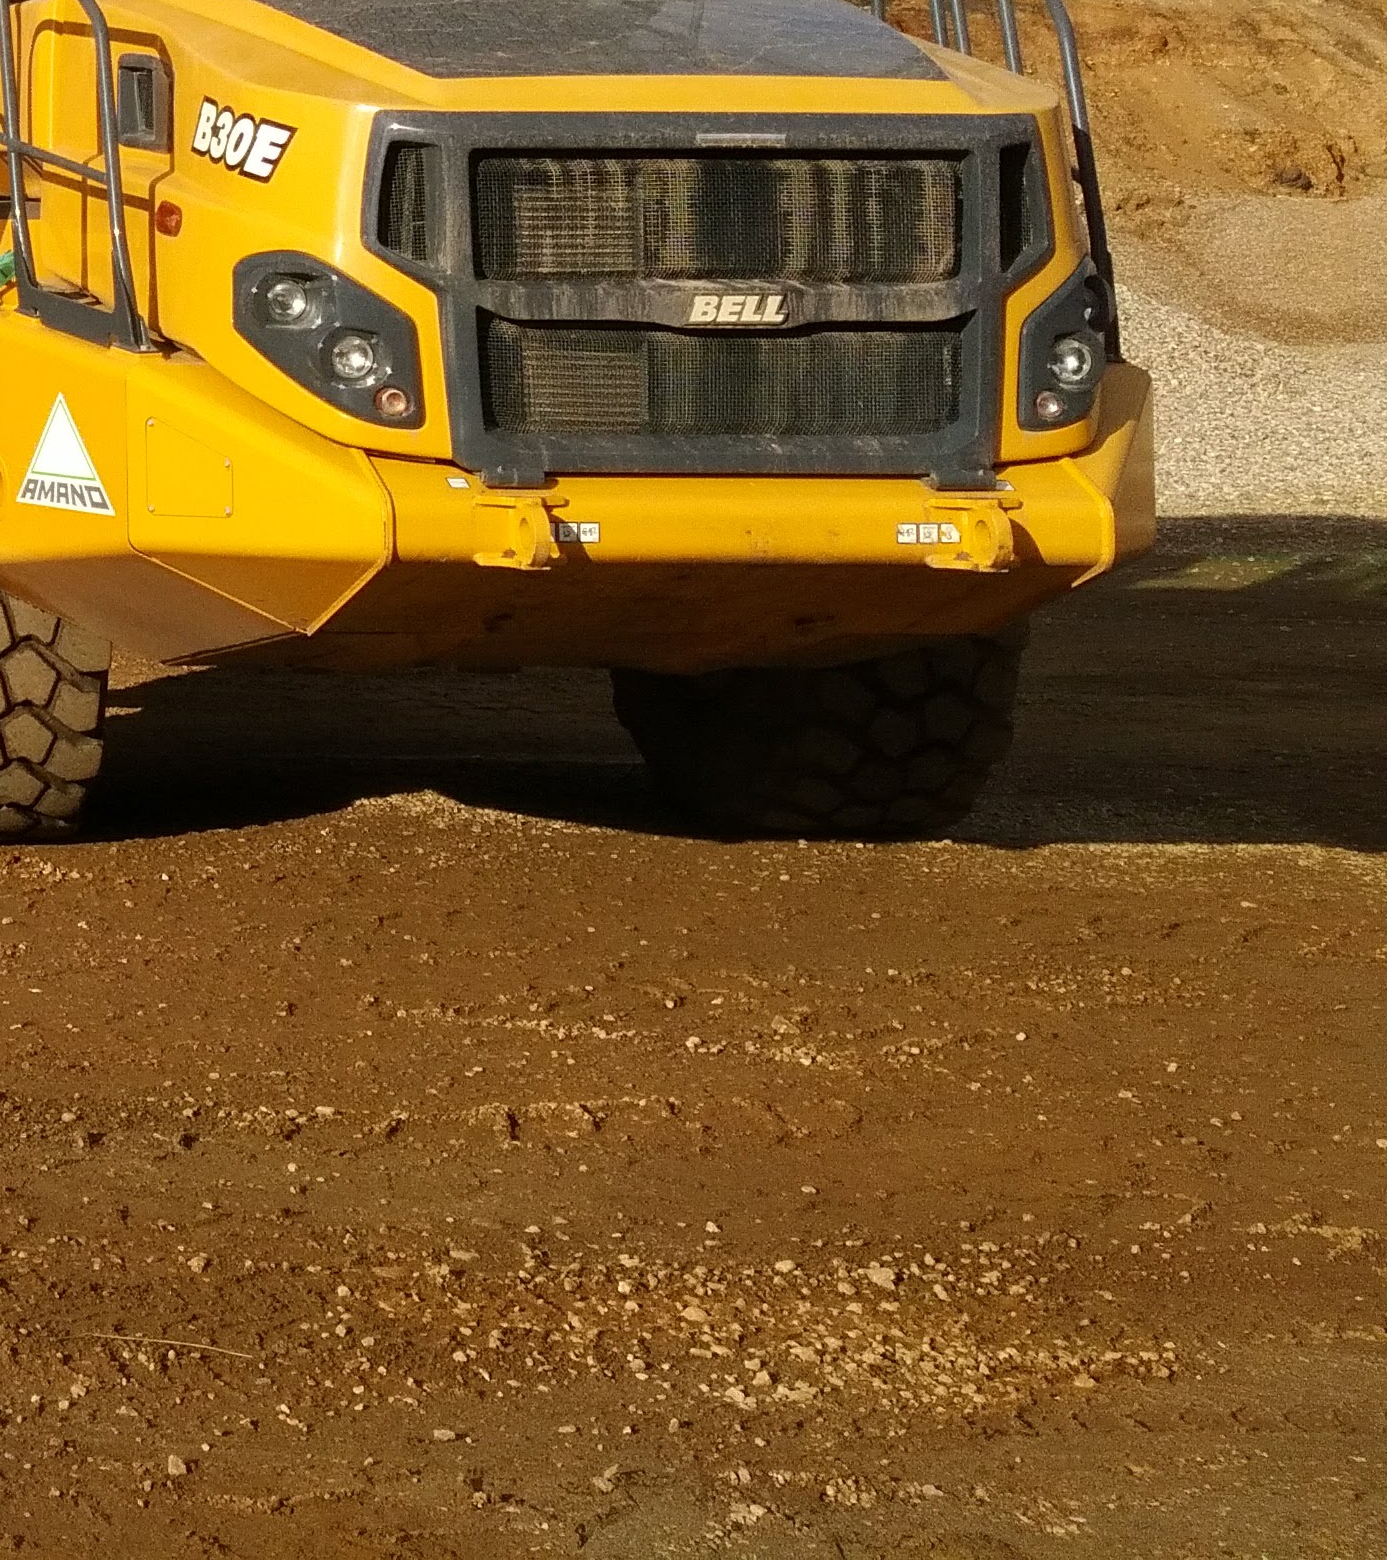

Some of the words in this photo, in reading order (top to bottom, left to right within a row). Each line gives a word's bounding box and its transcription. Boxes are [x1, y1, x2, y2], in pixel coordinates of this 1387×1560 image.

[191, 95, 298, 183] B30E
[688, 295, 785, 322] BELL
[20, 478, 110, 511] AMAND
